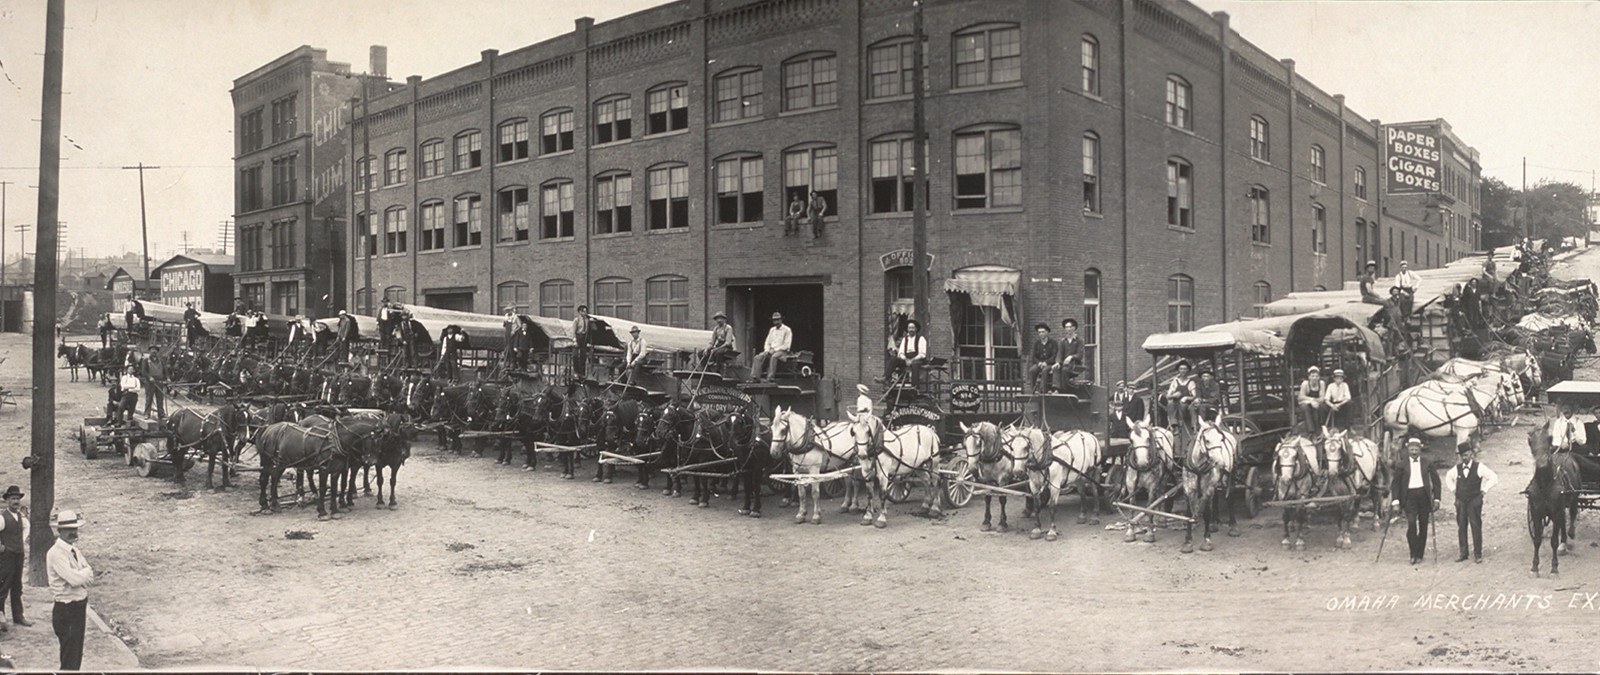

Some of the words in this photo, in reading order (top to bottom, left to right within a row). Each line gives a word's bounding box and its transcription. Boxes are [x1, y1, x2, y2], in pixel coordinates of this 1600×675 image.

[1388, 127, 1435, 148] PAPER
[1394, 142, 1440, 162] BOXES
[1388, 156, 1436, 178] CIGAR
[1395, 172, 1440, 192] BOXES
[162, 269, 202, 292] CHICAGO
[952, 384, 970, 395] CRANE
